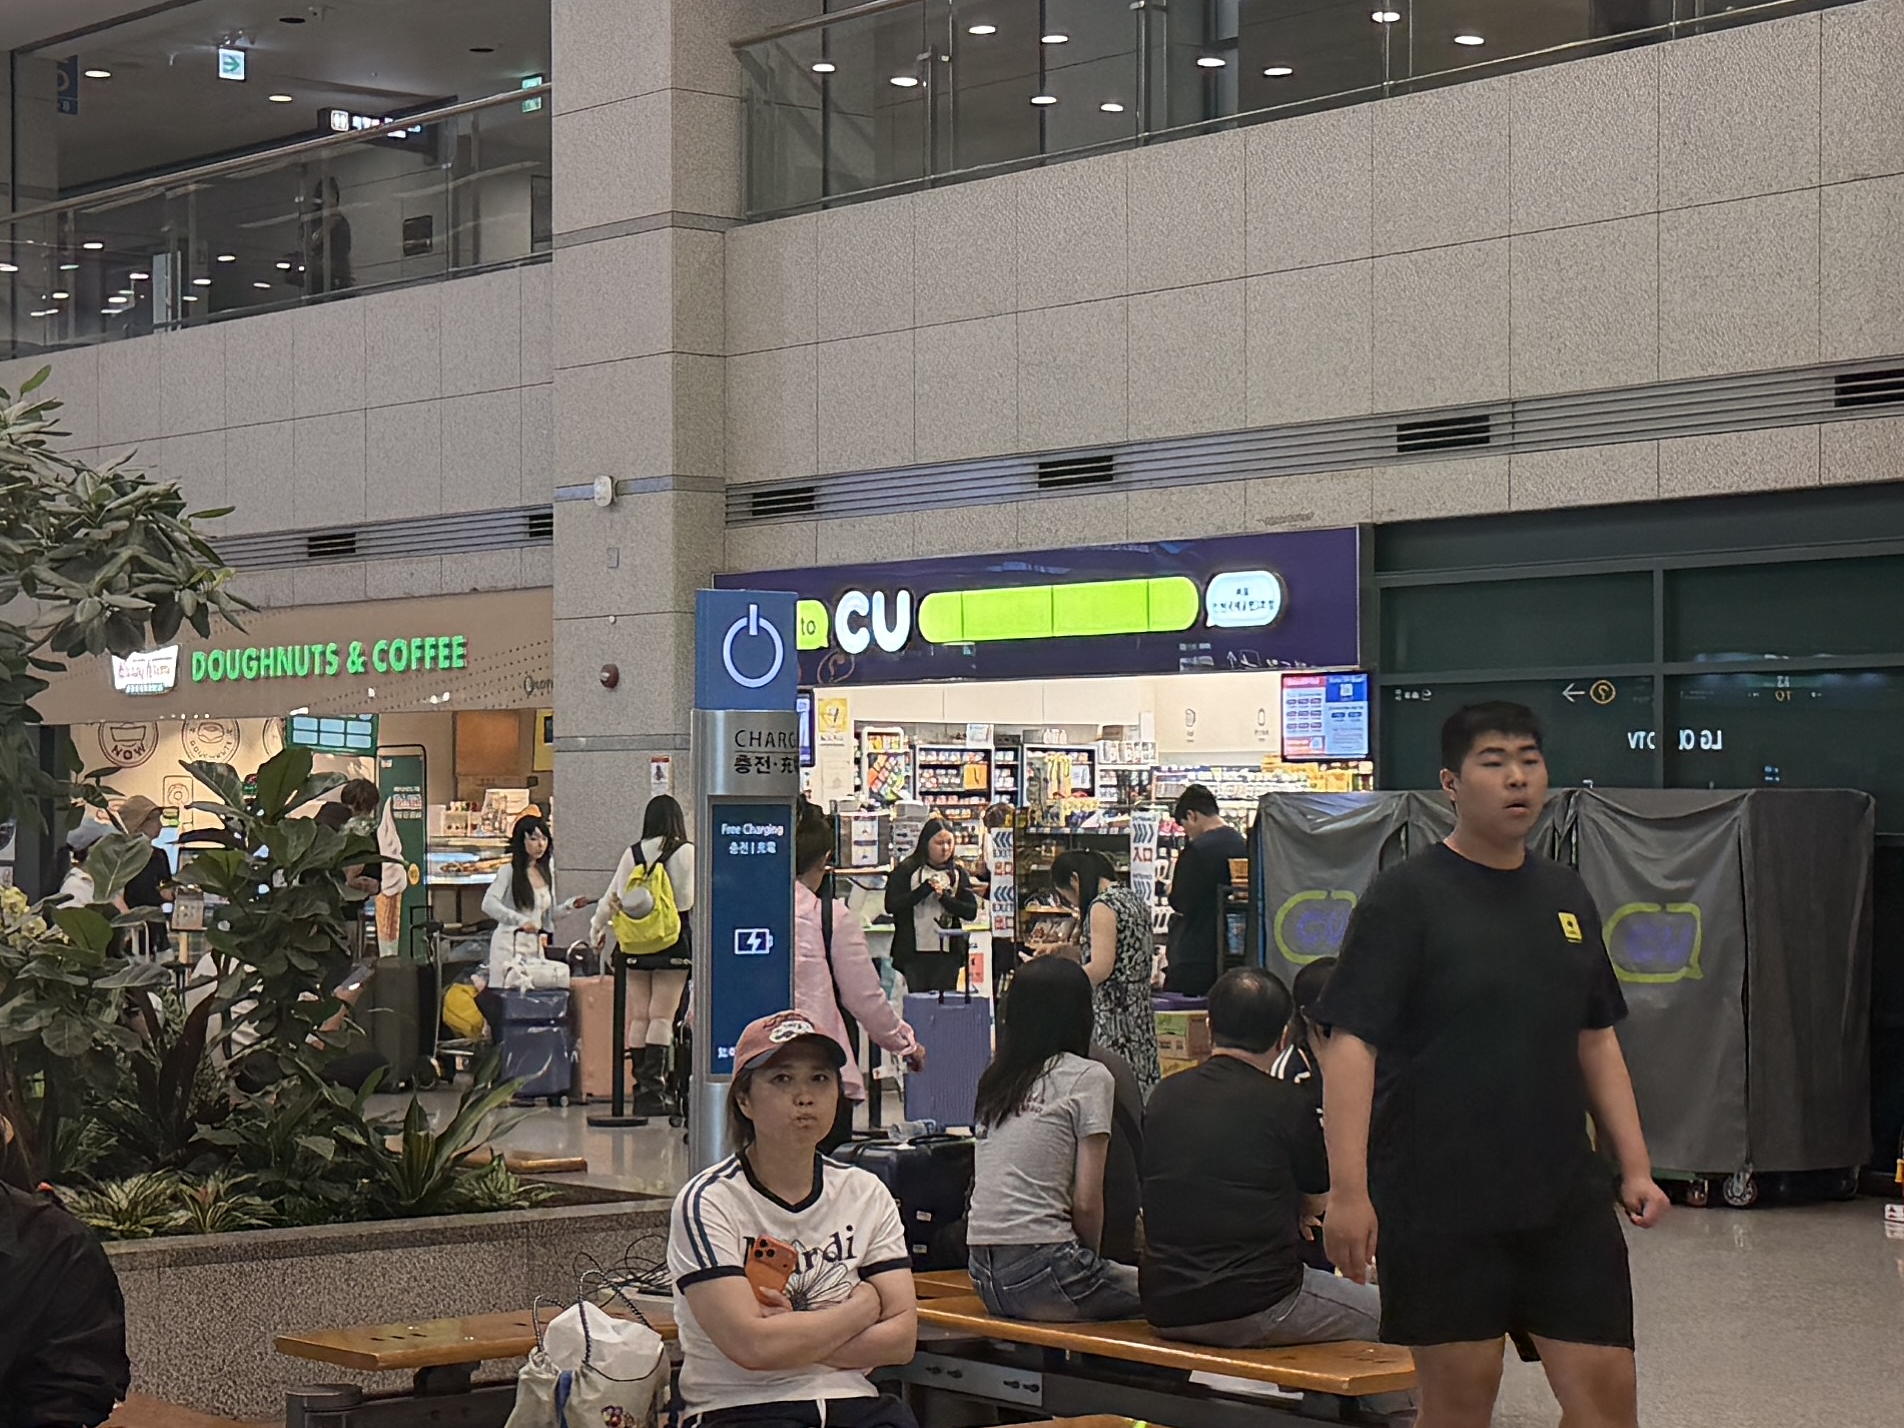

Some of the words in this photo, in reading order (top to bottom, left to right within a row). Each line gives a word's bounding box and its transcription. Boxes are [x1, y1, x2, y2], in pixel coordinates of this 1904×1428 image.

[801, 617, 816, 636] to
[835, 589, 911, 654] CU
[191, 641, 339, 683] DOUGHNUTS
[345, 639, 367, 675] &
[372, 634, 468, 674] COFFEE
[112, 741, 147, 761] NOW
[721, 823, 741, 836] Free
[742, 823, 785, 837] Charging
[1132, 846, 1154, 863] 入口
